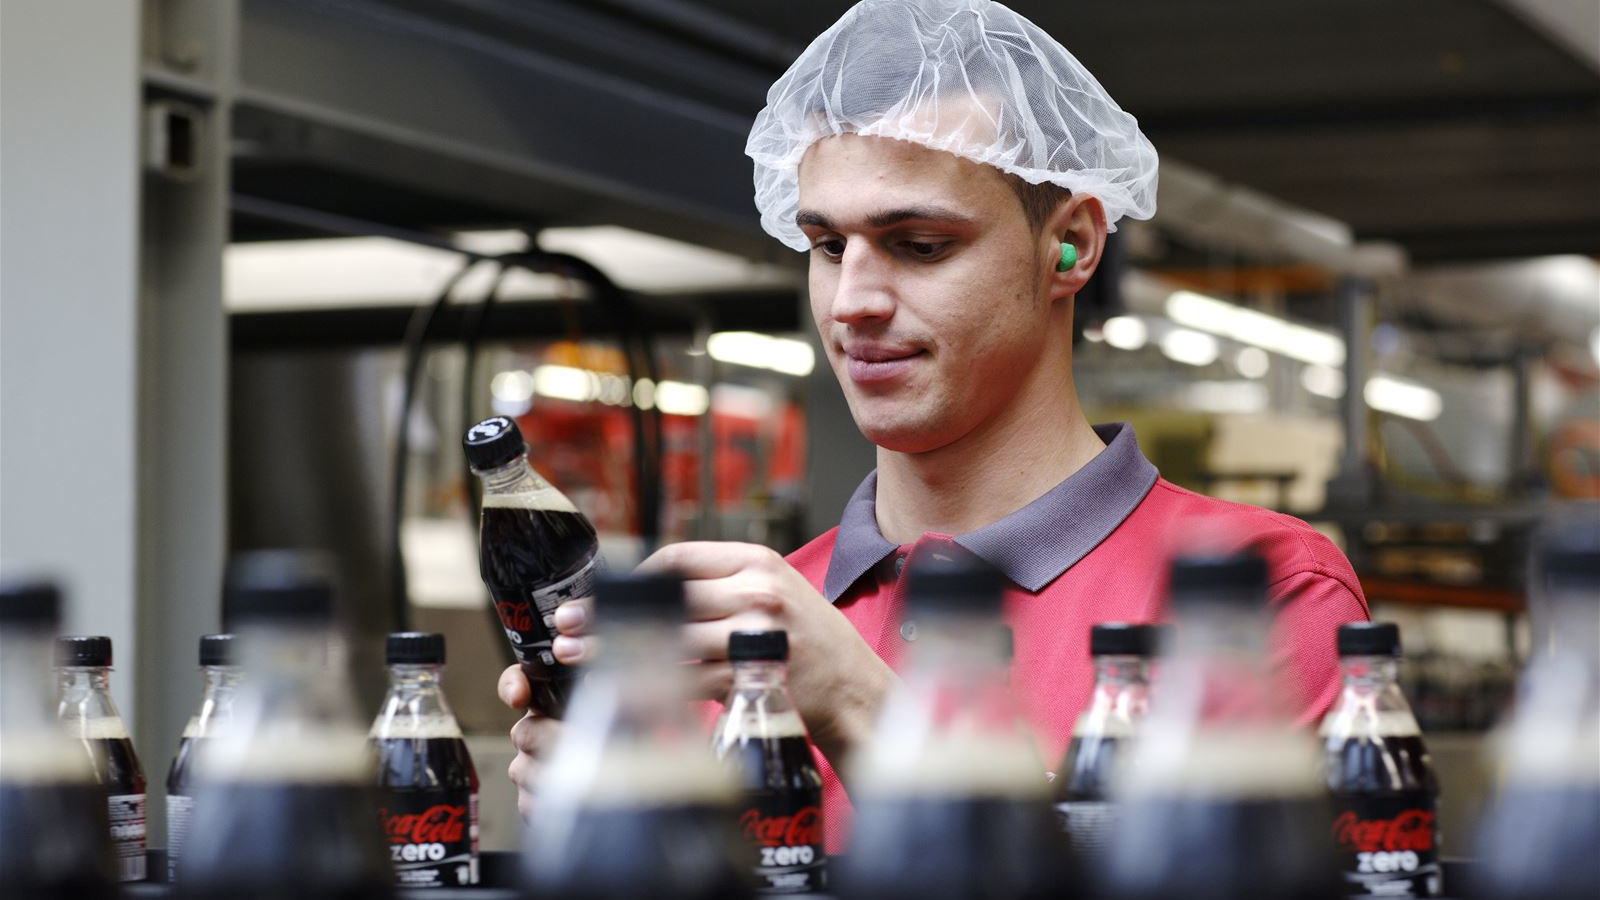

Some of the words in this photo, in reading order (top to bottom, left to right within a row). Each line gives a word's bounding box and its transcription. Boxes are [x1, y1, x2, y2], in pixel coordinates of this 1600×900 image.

[390, 842, 446, 861] zero
[760, 845, 814, 866] zero
[1357, 849, 1419, 872] zero
